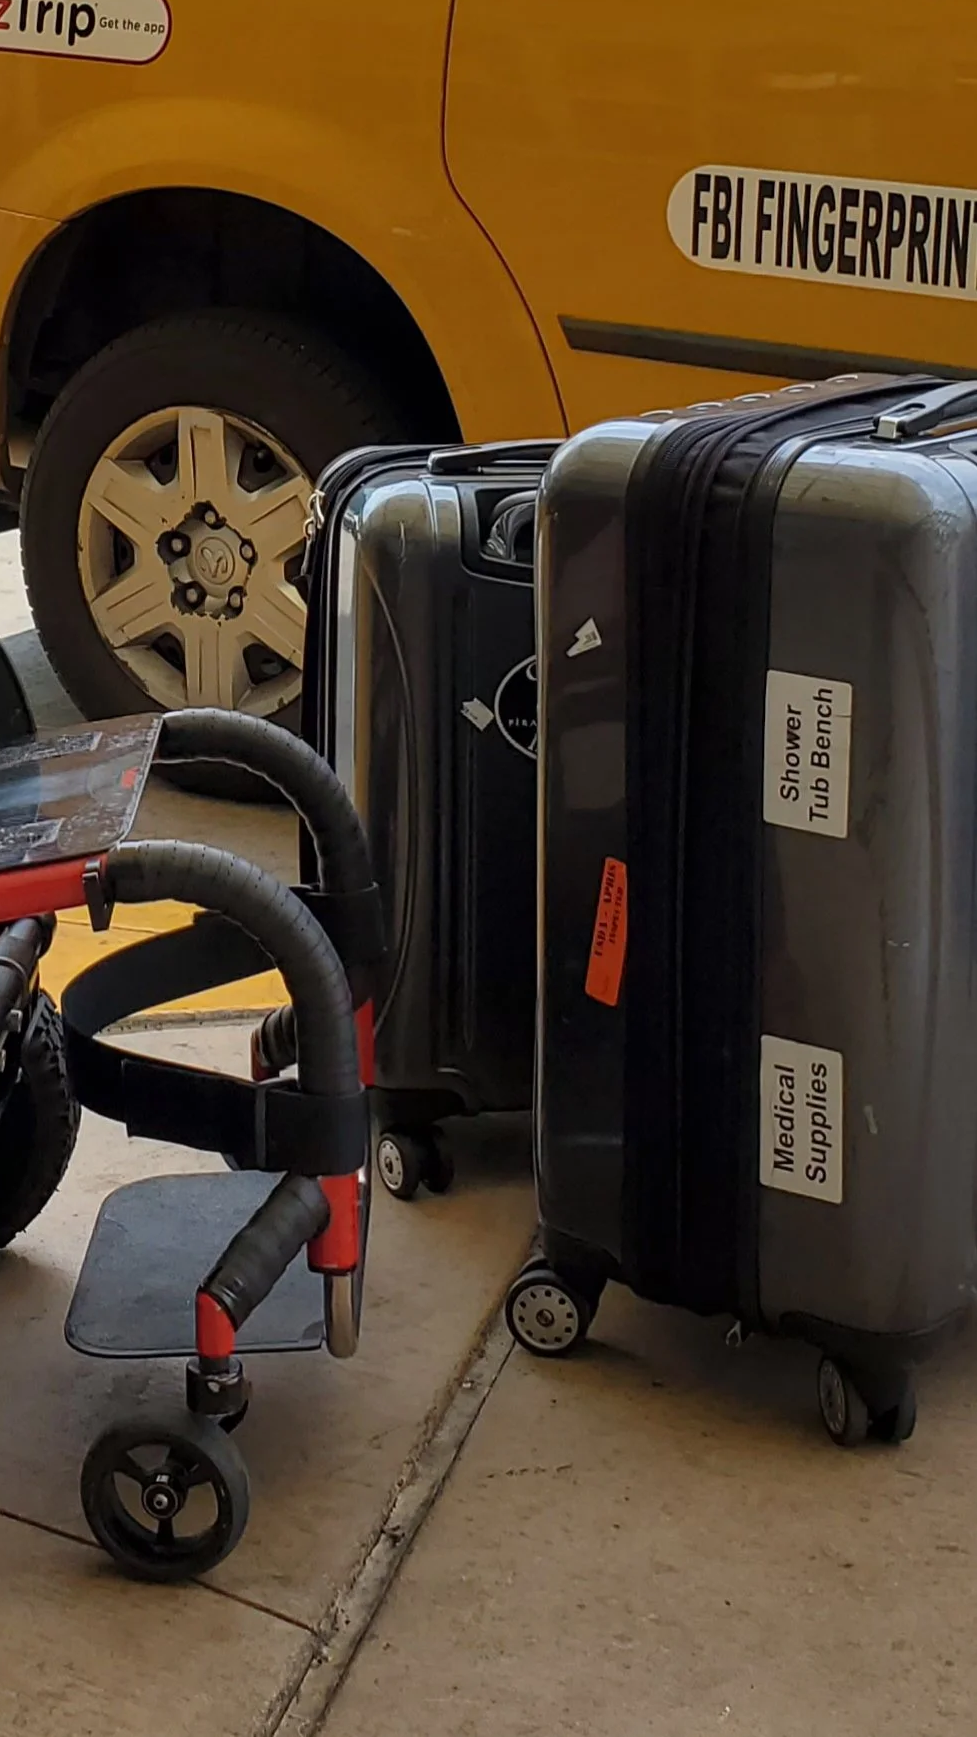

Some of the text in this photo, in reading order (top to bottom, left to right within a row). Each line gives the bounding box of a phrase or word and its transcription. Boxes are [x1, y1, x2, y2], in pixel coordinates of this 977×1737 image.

[99, 16, 166, 35] Get the app
[691, 173, 977, 290] FBI FINGERPRIN
[779, 704, 802, 803] Shower
[809, 688, 834, 822] Tub Bench
[773, 1064, 795, 1173] Medical
[805, 1062, 833, 1184] Supplies
